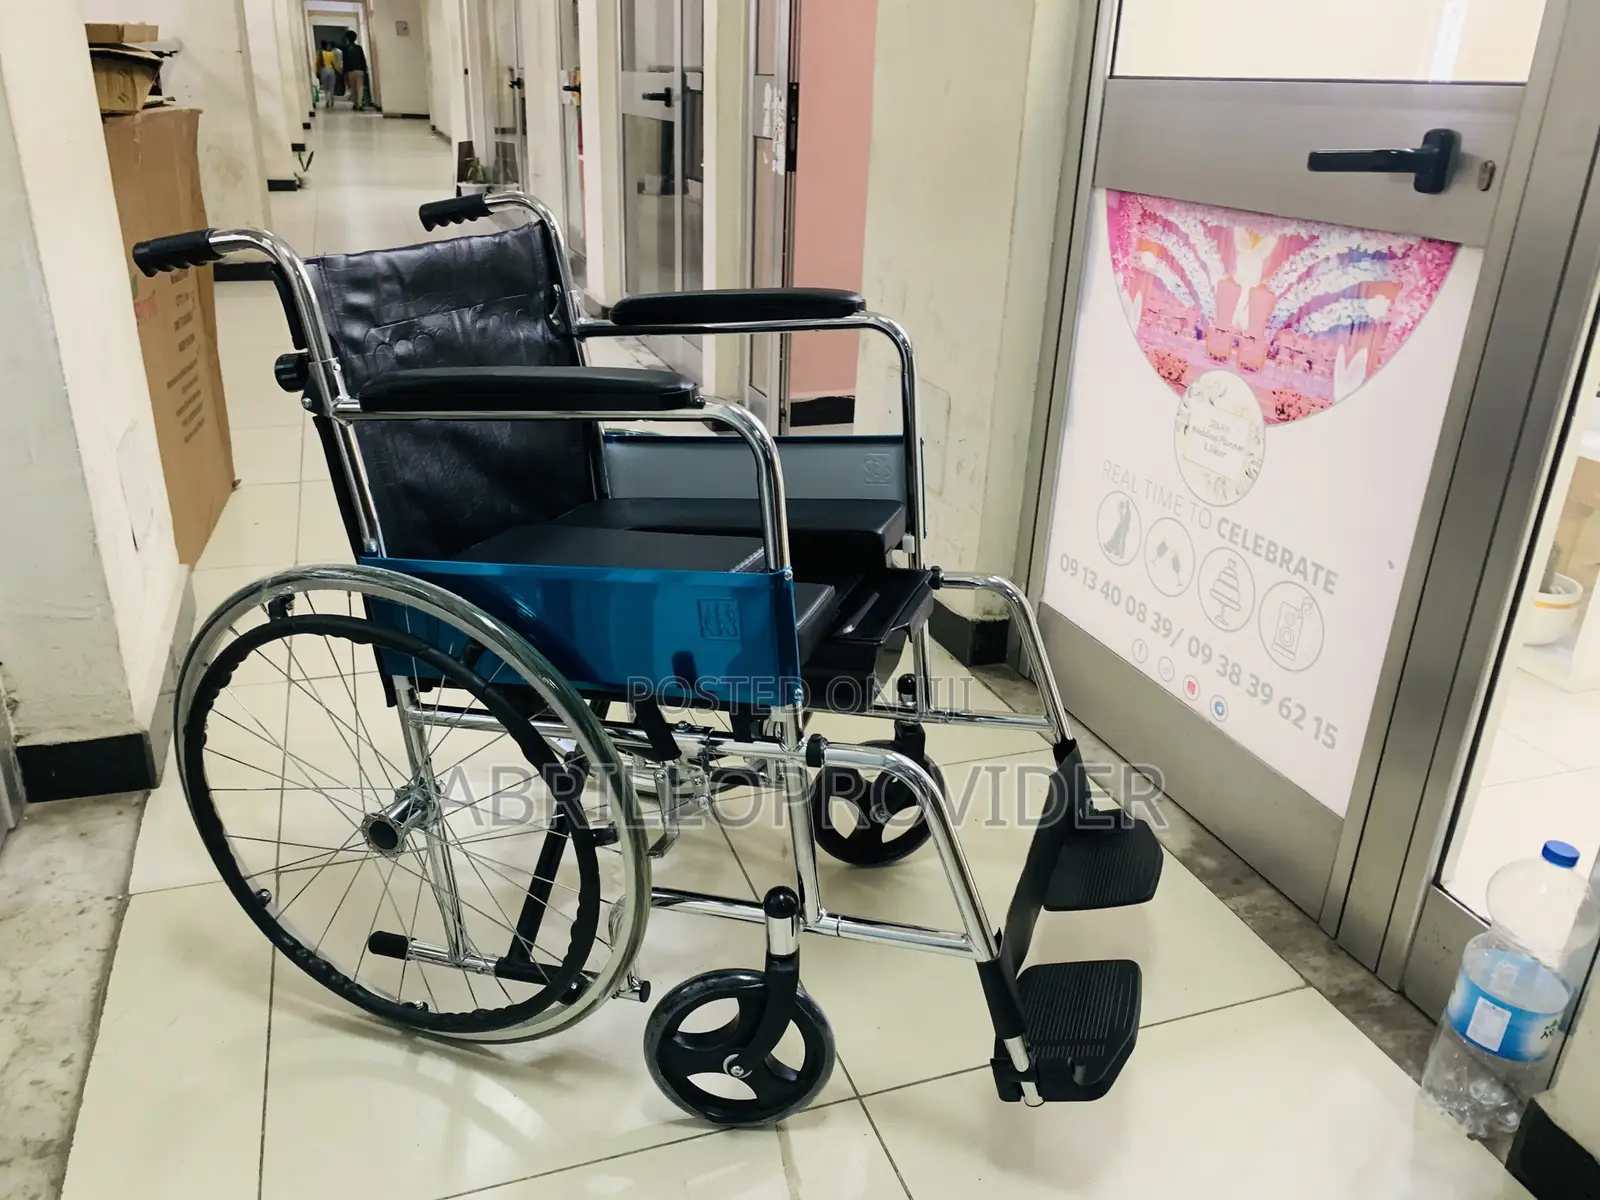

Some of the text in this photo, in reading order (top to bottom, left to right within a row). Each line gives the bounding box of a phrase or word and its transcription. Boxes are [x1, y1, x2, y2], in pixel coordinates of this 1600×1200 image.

[1102, 459, 1339, 596] REAL TIME TO CELEBRATE
[1060, 552, 1078, 577] 09
[1082, 566, 1098, 591] 13
[1100, 580, 1122, 607] 40
[1125, 594, 1148, 624] 08
[1188, 635, 1213, 665] 09
[1216, 653, 1242, 687] 38
[1246, 672, 1274, 705] 39
[1278, 696, 1308, 732] 62
[1313, 715, 1339, 750] 15
